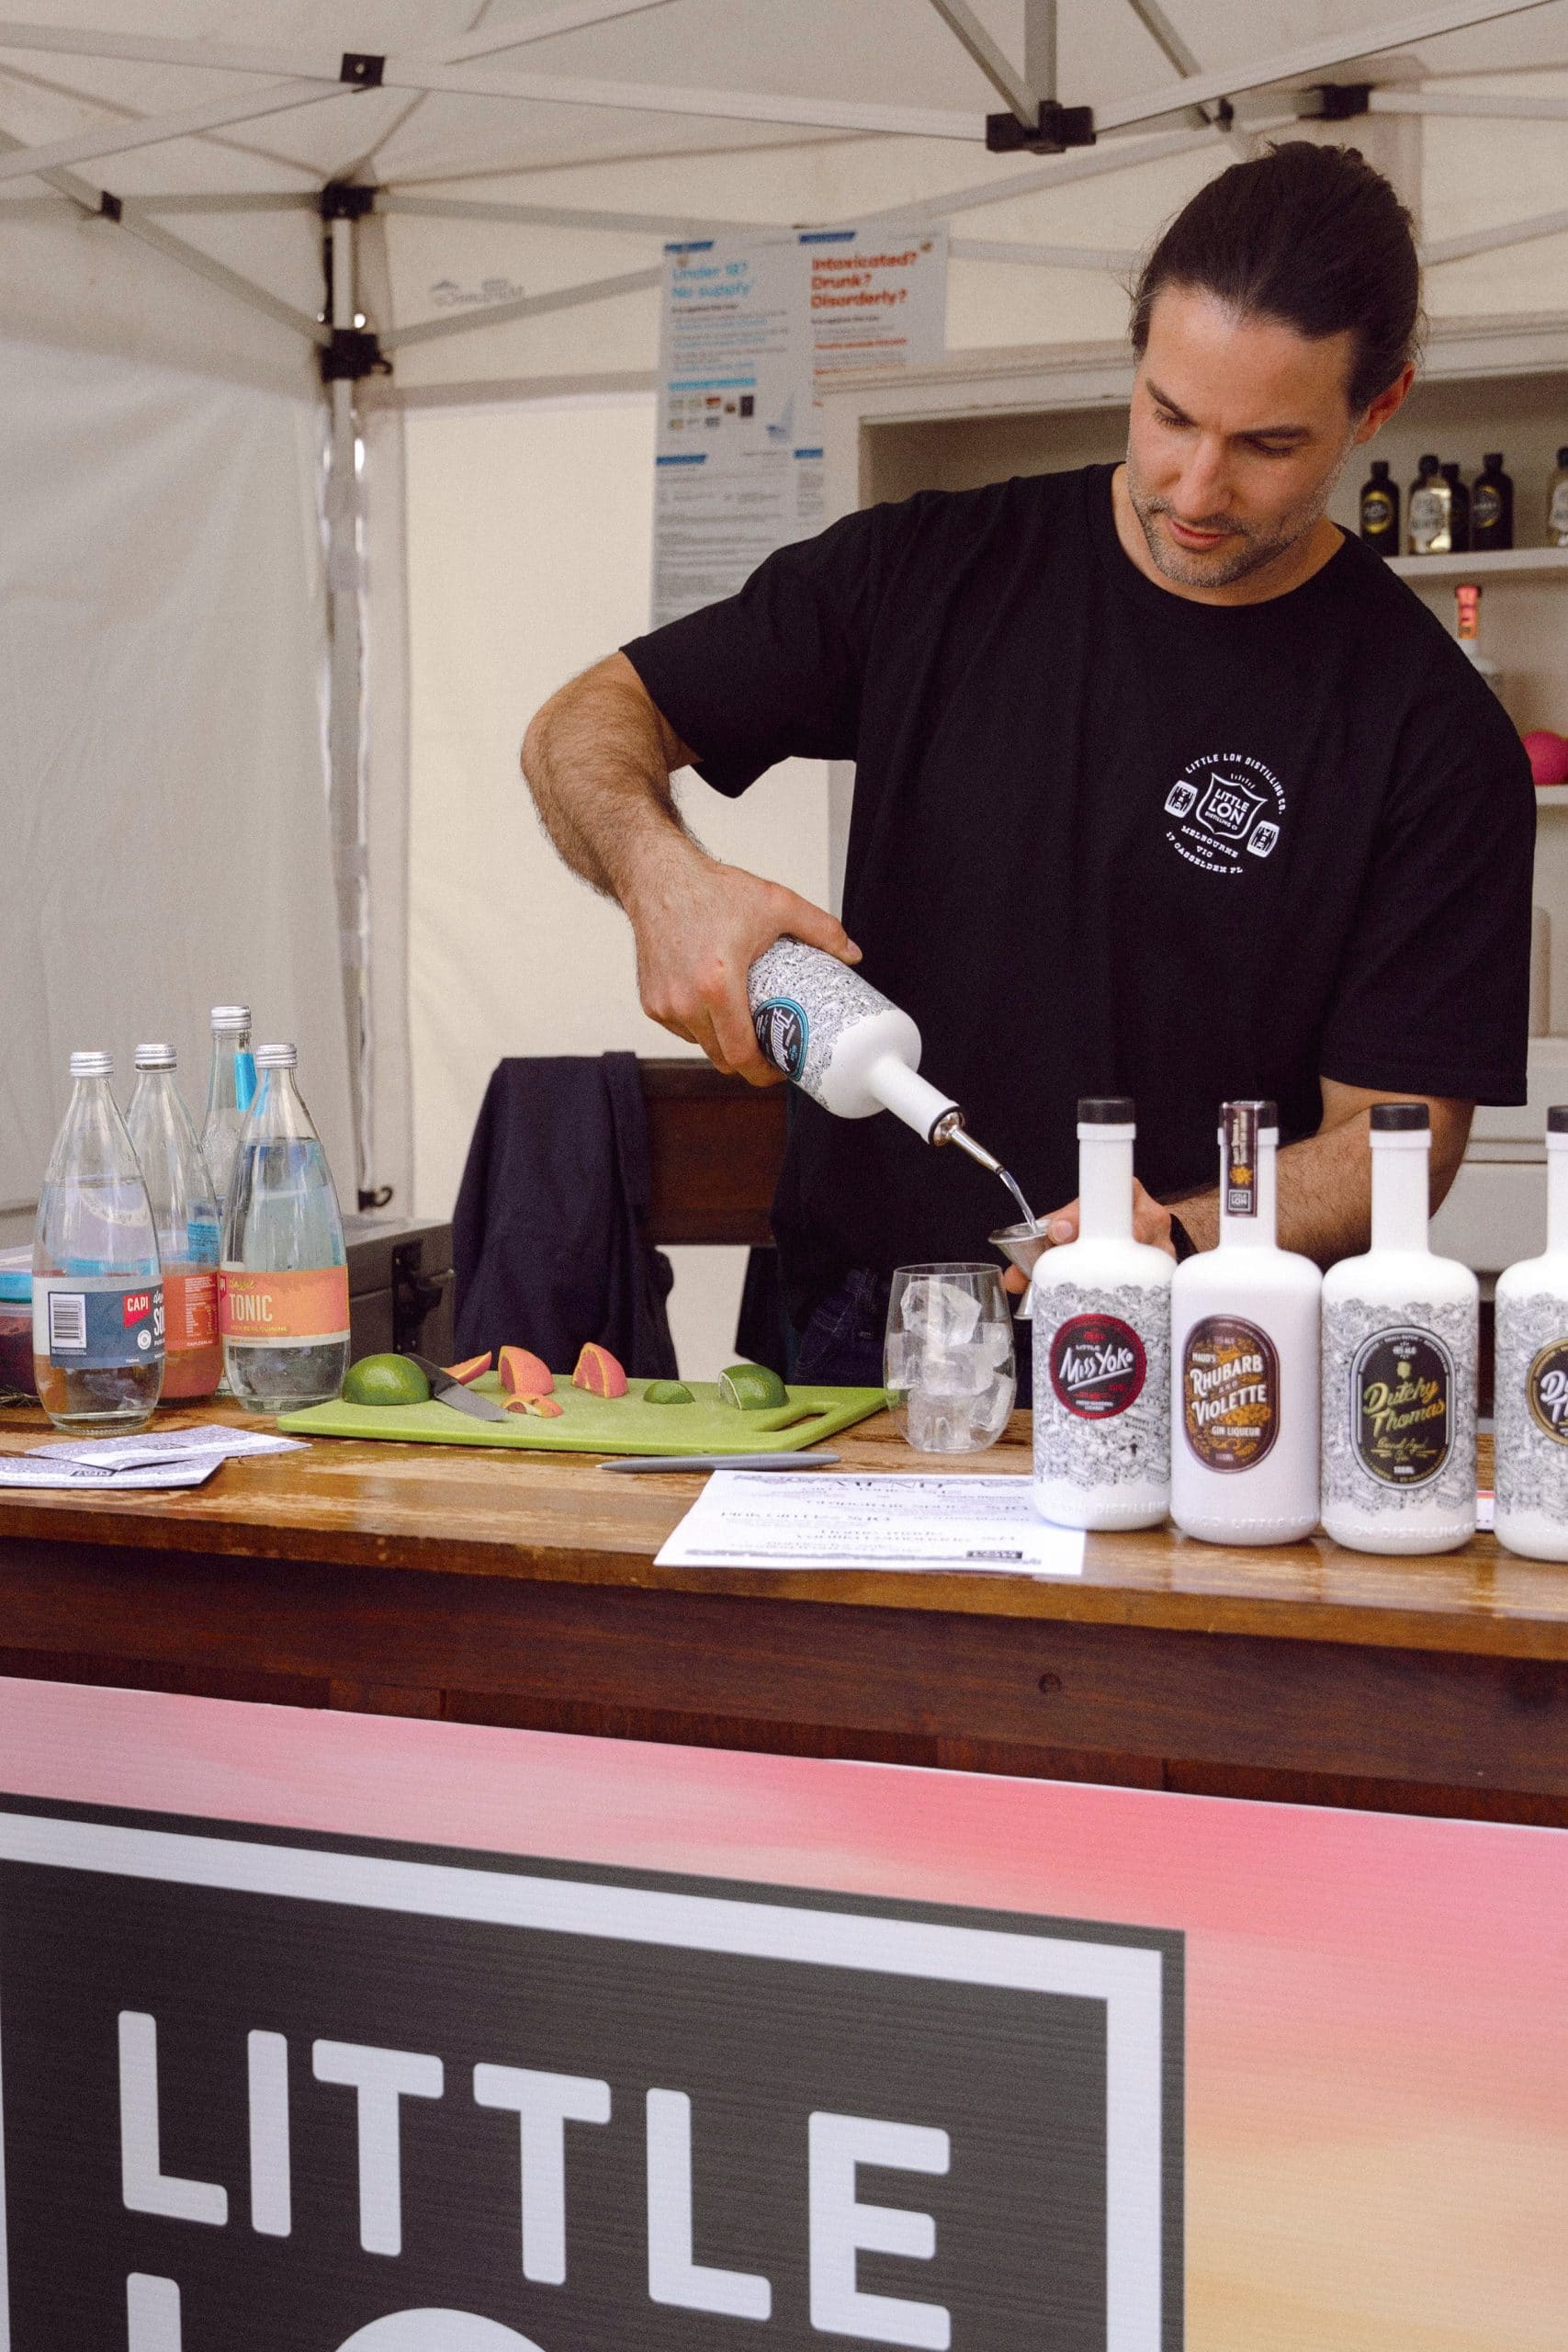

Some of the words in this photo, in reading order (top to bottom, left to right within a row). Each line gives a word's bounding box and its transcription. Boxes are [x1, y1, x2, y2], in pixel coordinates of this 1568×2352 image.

[812, 251, 917, 272] Intoxicated?
[811, 274, 871, 290] Drunk?
[810, 288, 908, 309] Disorderly?
[1185, 753, 1219, 774] LITTLE
[1224, 753, 1242, 762] LON
[1245, 757, 1284, 797] DISTILLING
[1208, 798, 1245, 825] LON
[1214, 788, 1250, 812] LITTLE
[1205, 811, 1231, 827] DISTILLING
[1166, 831, 1175, 842] 17
[1174, 842, 1227, 873] CASSELDEN
[1181, 825, 1238, 858] MELBOURNE
[1197, 845, 1213, 858] VIC
[127, 1295, 149, 1312] CAPI
[229, 1294, 273, 1322] TONIC
[1076, 1344, 1101, 1352] LITTLE
[1190, 1353, 1264, 1398] RHUBARB
[1190, 1384, 1267, 1427] VIOLETTE
[1363, 1377, 1439, 1415] Dutchy
[1212, 1426, 1225, 1436] GIN
[1226, 1427, 1261, 1438] LIQUEUR
[1369, 1399, 1446, 1439] Thomas
[118, 2010, 952, 2352] LITTLE
